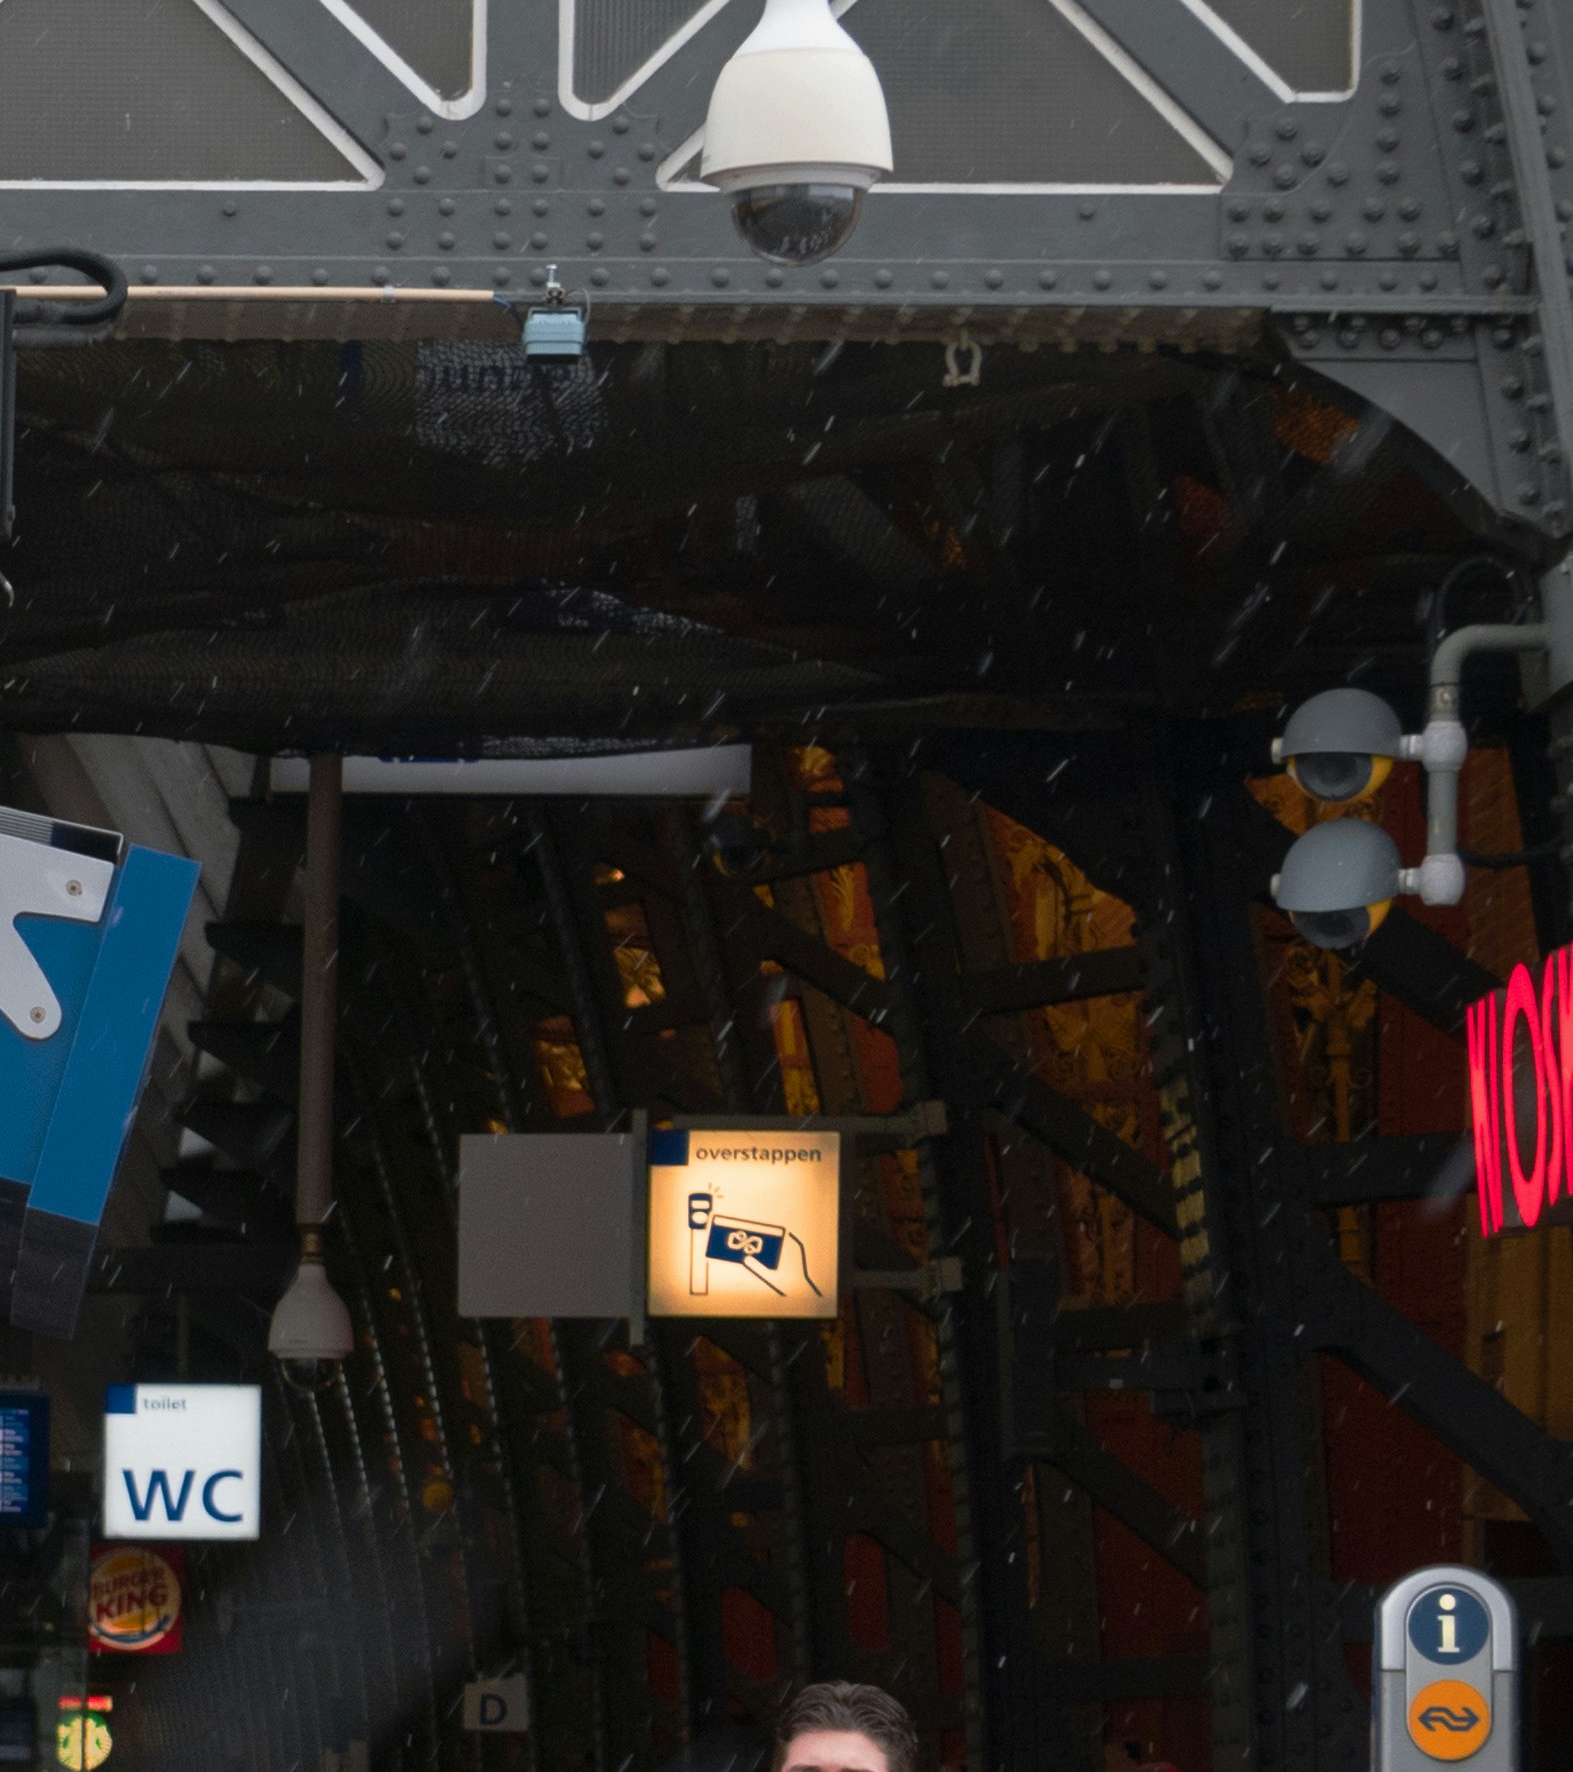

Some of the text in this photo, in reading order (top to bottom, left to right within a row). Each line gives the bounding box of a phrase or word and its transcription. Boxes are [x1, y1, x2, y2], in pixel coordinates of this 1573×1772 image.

[696, 1147, 822, 1165] overstappen
[143, 1397, 187, 1411] toilet
[122, 1469, 244, 1523] WC
[96, 1583, 169, 1622] KING
[480, 1693, 508, 1724] D
